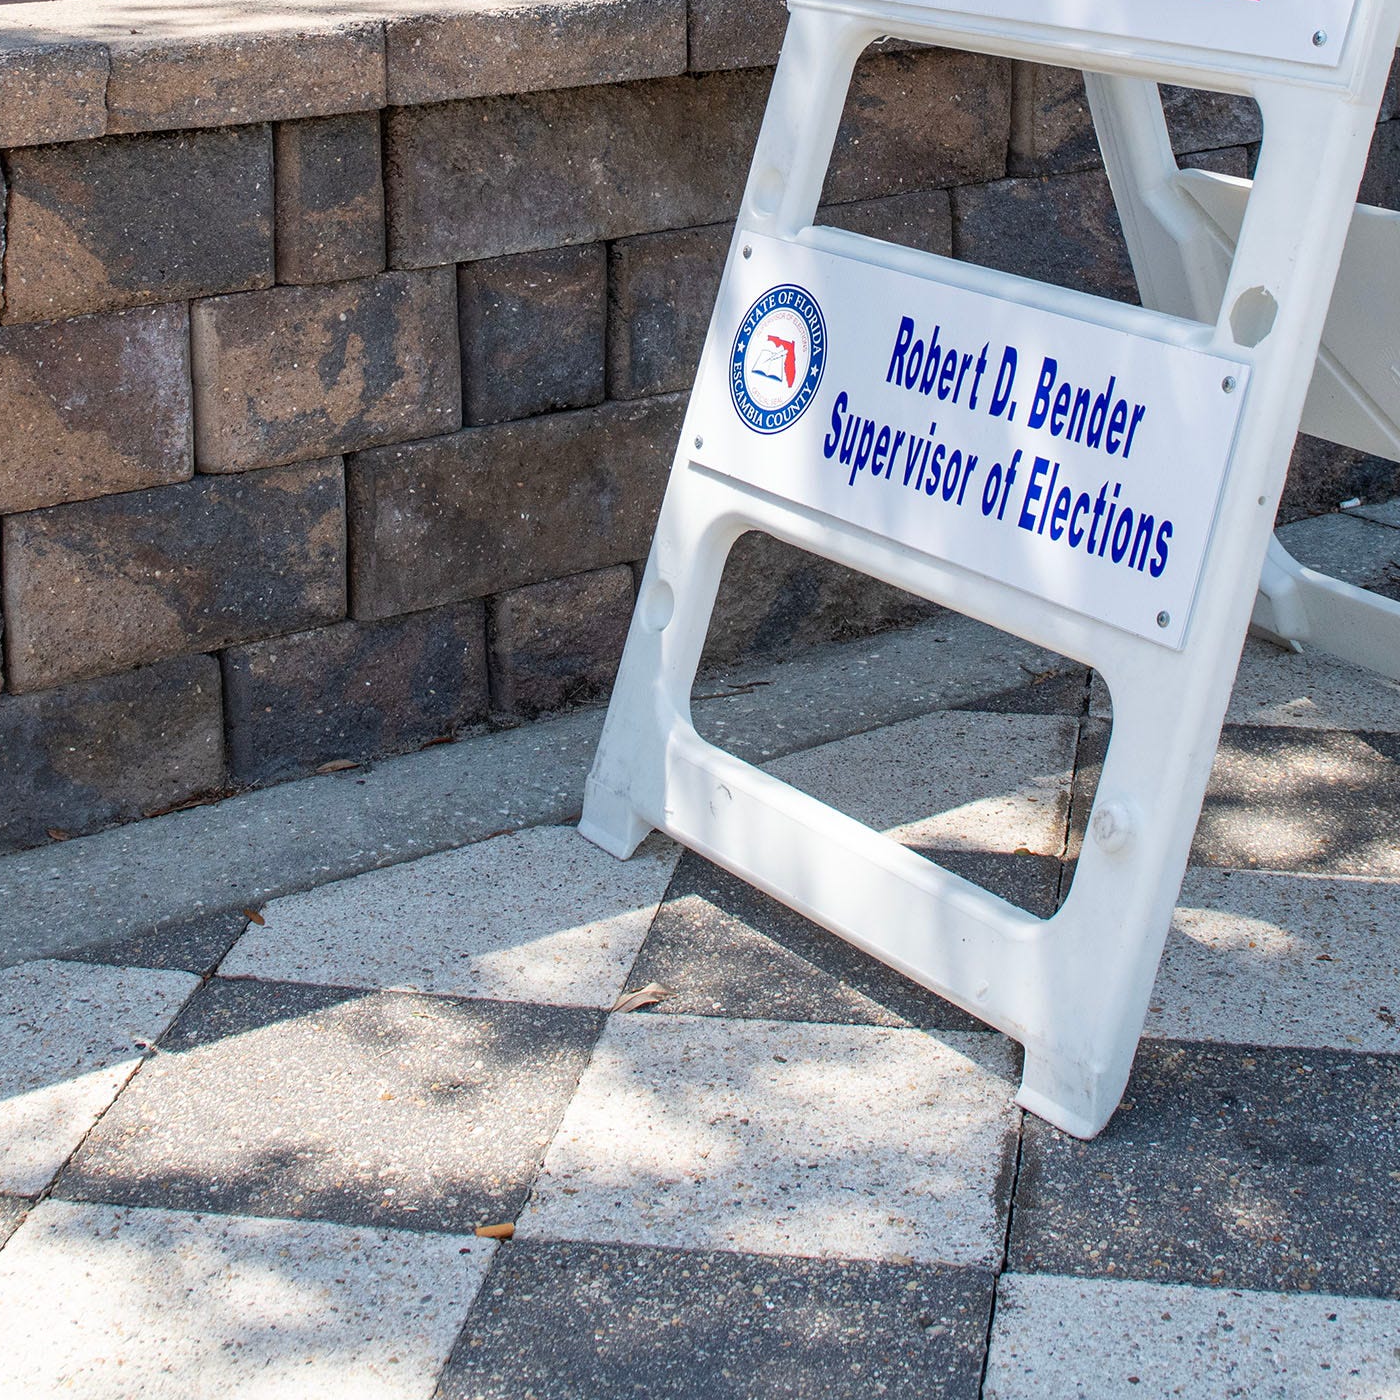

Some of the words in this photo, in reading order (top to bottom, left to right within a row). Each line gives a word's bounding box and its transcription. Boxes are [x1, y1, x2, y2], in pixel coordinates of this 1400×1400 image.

[743, 294, 776, 336] STATE
[778, 291, 794, 305] OF
[794, 294, 822, 356] FLORIDA
[733, 362, 763, 427] ESCAMBIA
[765, 382, 812, 428] COUNTY
[886, 315, 991, 410] Robert
[989, 345, 1018, 422] D.
[1027, 356, 1145, 459] Bender
[823, 391, 979, 506] Supervisor
[982, 450, 1023, 521] of
[1017, 455, 1174, 579] Elections
